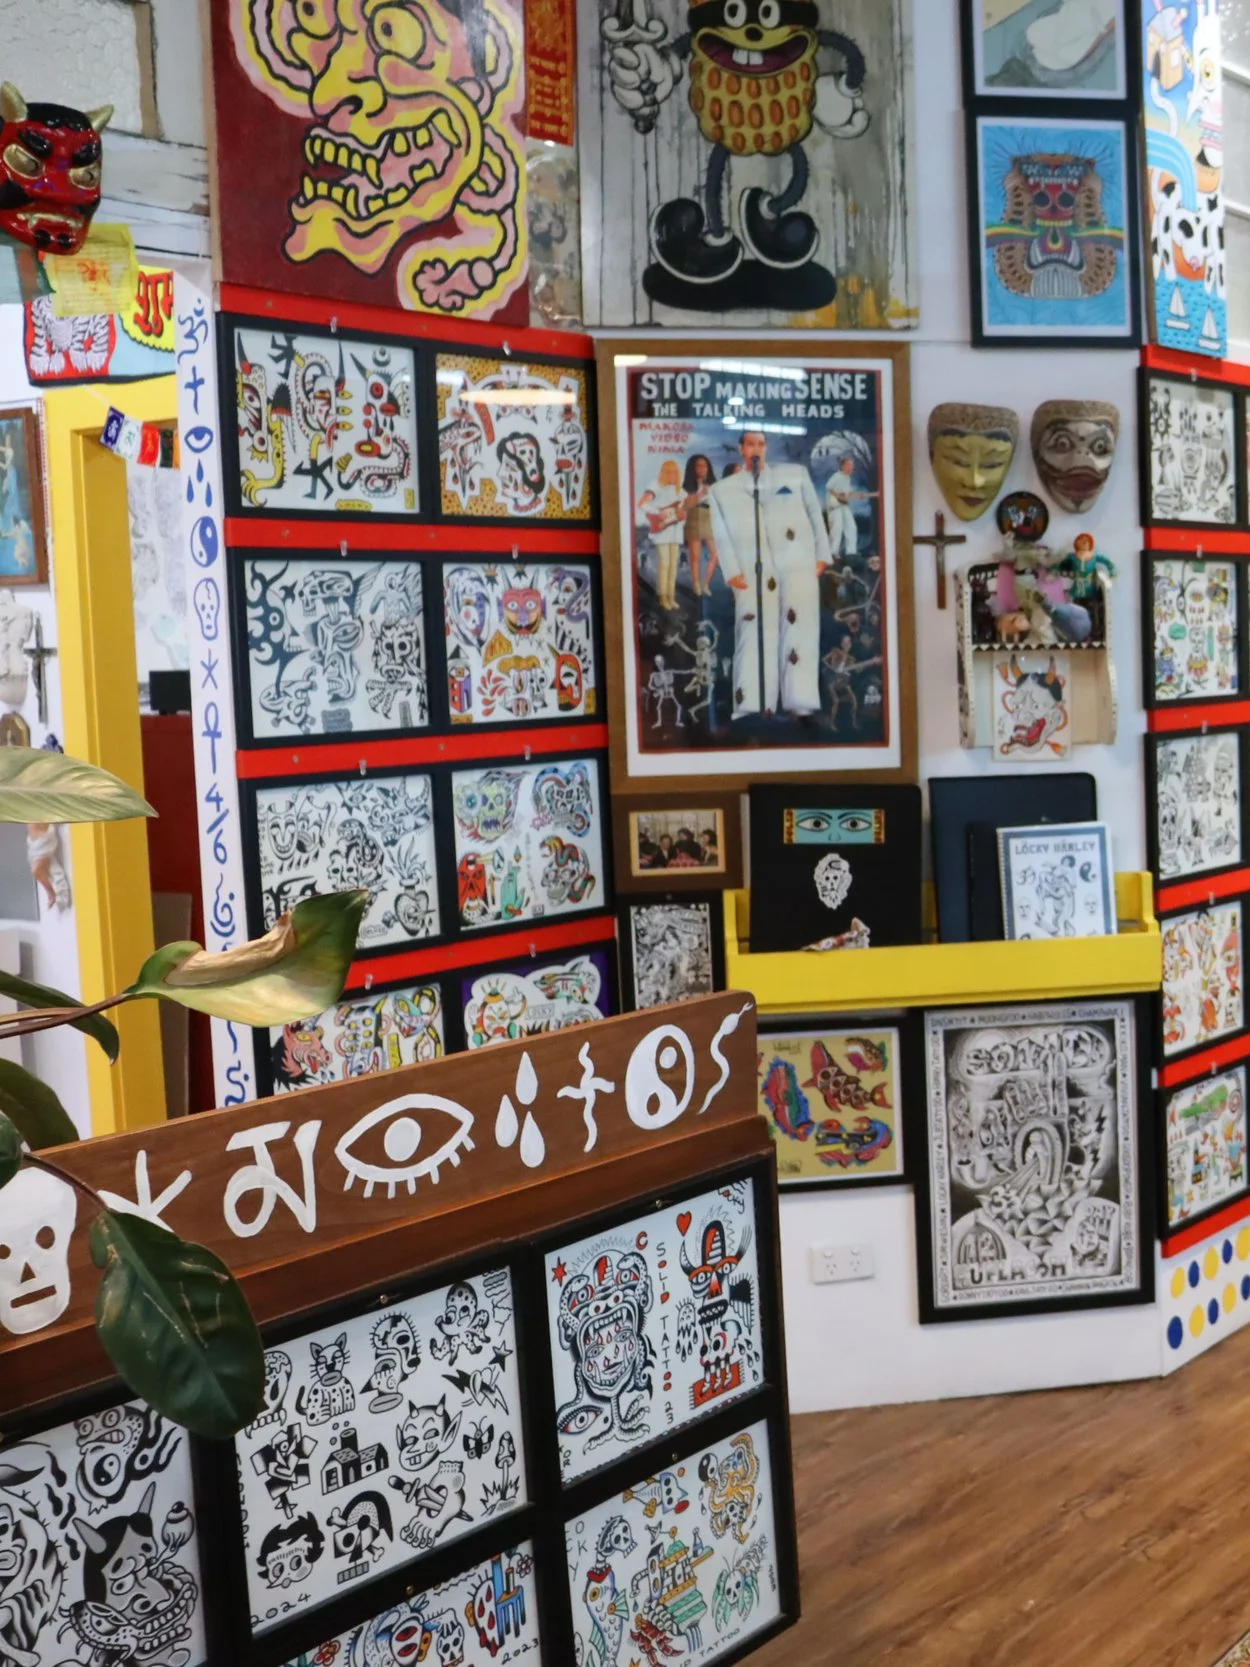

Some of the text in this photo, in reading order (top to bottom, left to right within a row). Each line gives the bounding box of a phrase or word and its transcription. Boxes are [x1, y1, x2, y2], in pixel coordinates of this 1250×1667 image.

[640, 371, 868, 400] STOP MAKING SENSE
[652, 401, 845, 419] THE TALKING HEADS
[656, 1242, 671, 1305] SOLID
[660, 1315, 673, 1392] TATTOO
[250, 1593, 312, 1628] 2024
[501, 1637, 540, 1665] 2023
